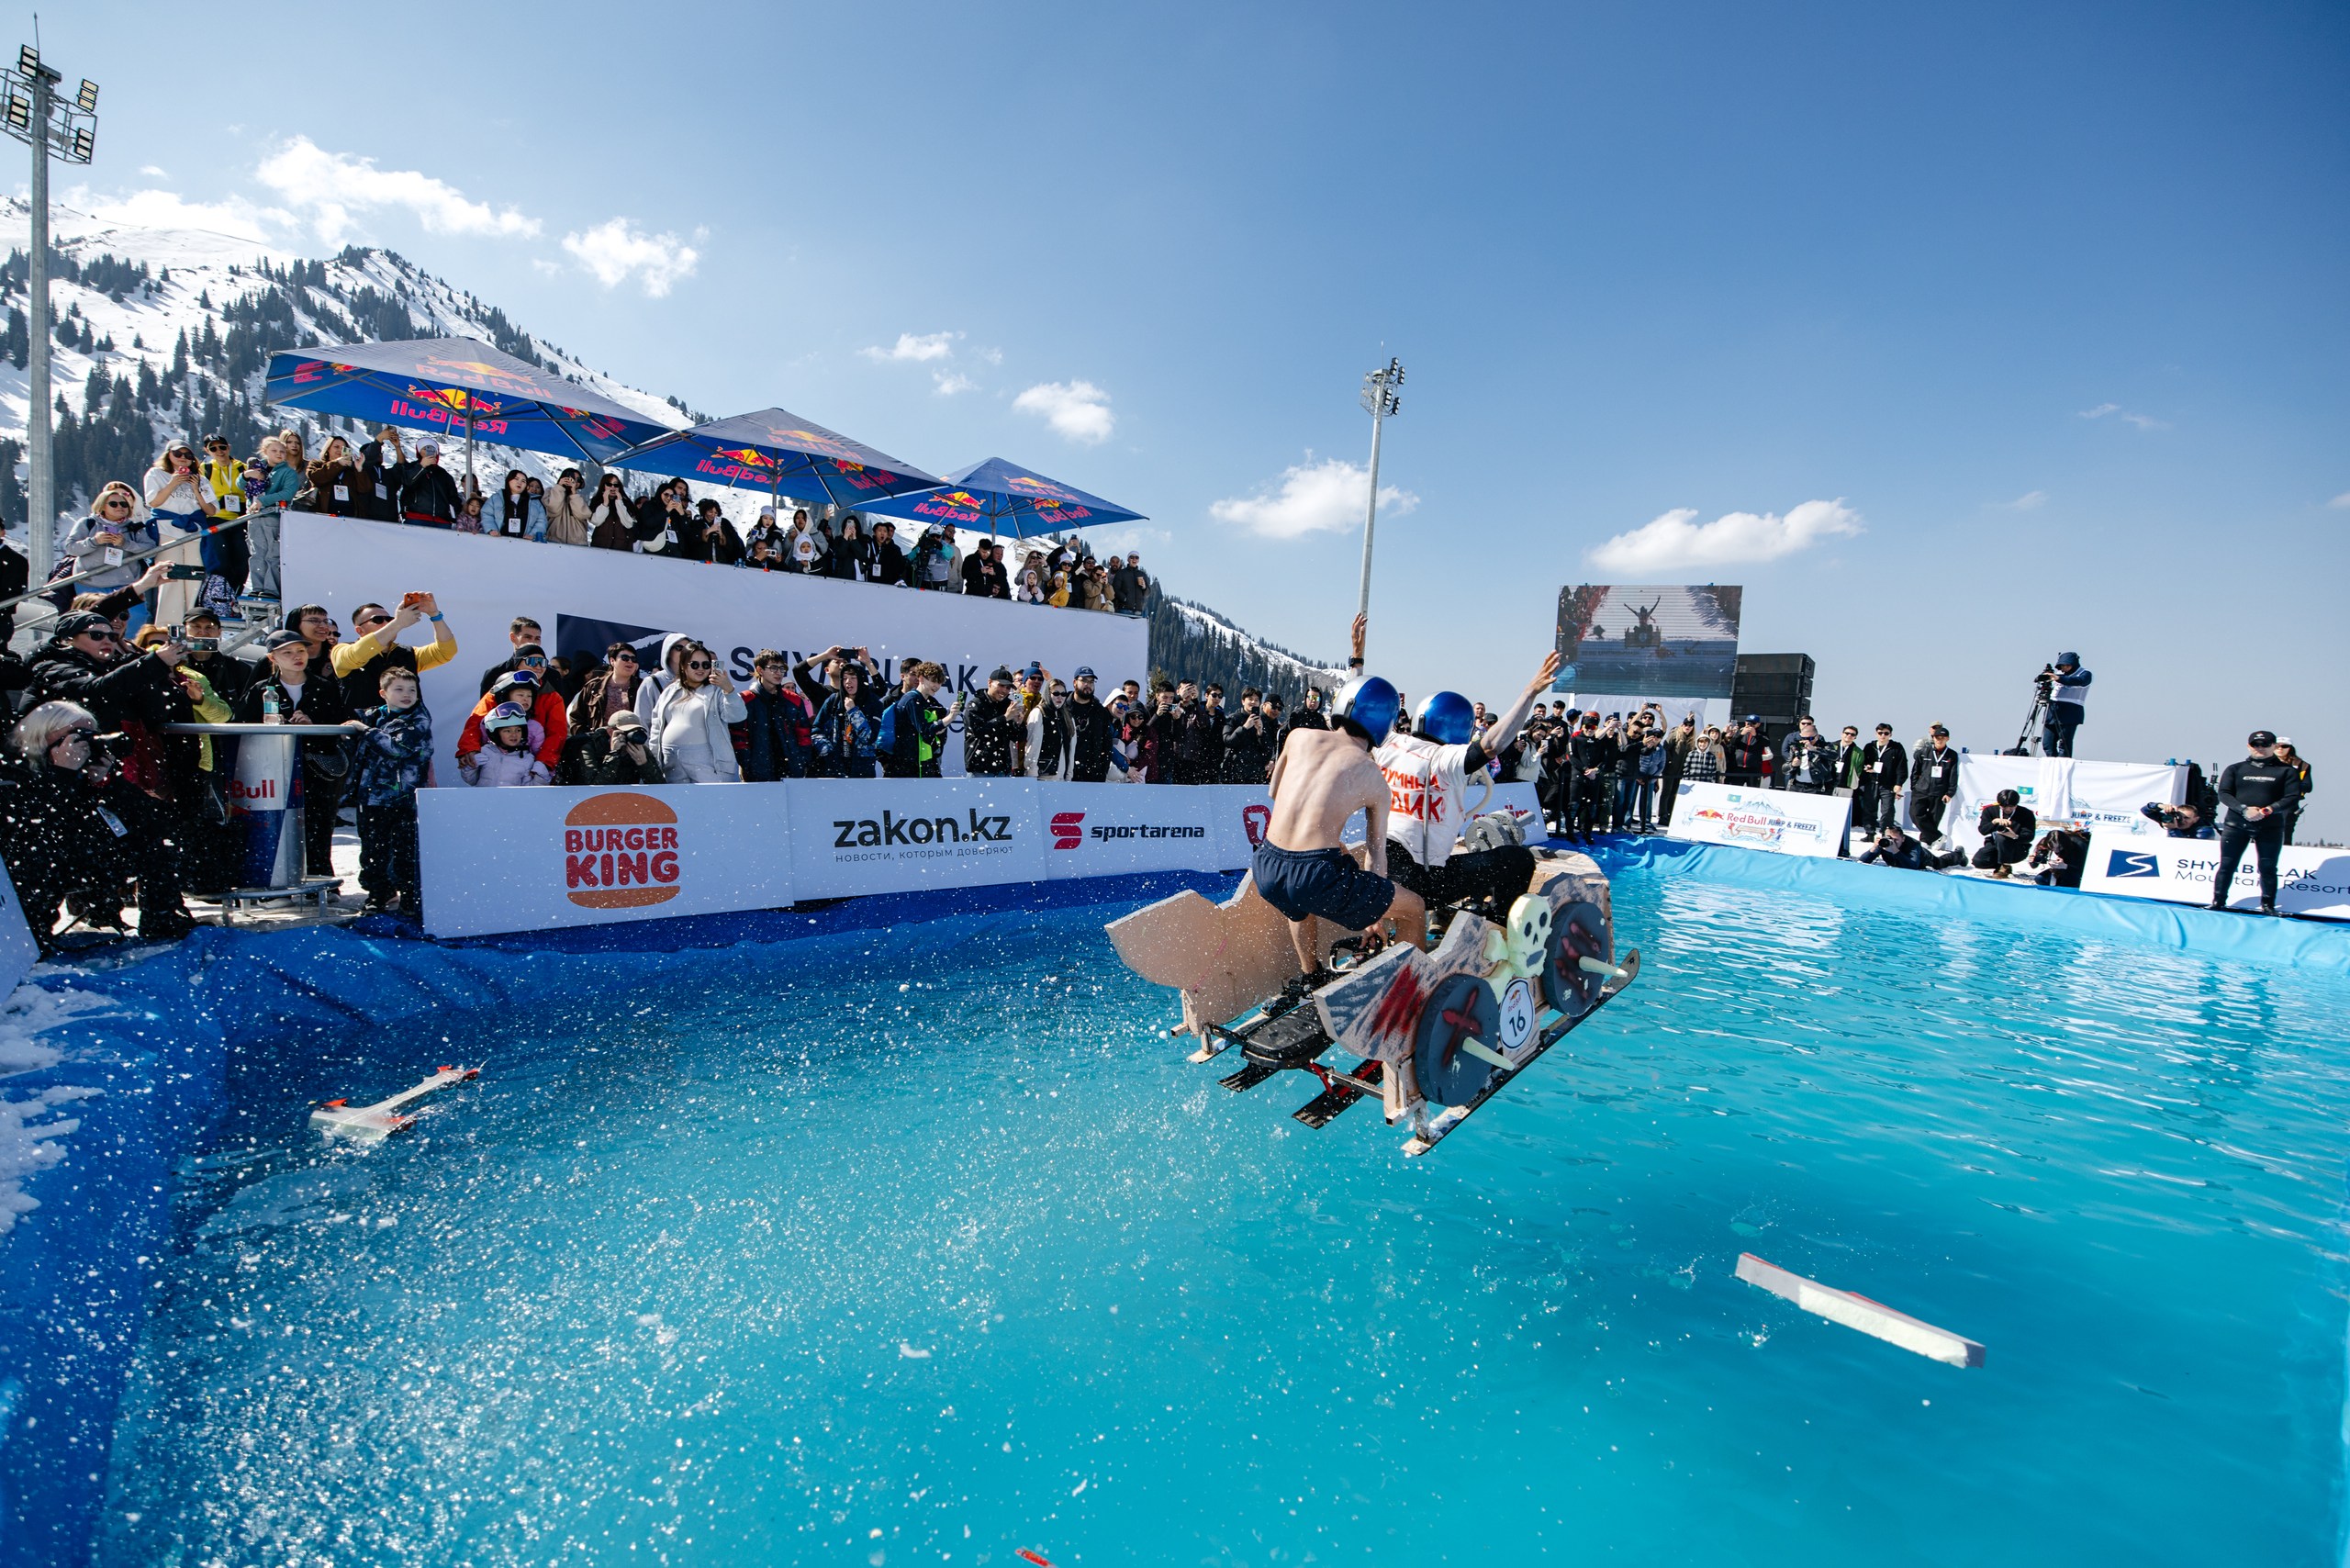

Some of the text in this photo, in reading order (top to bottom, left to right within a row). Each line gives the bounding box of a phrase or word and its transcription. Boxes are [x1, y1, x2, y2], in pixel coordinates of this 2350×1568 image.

[416, 364, 553, 399] Red Bull
[231, 779, 275, 799] Bull
[833, 808, 1013, 848] zakon.kz
[1091, 823, 1204, 842] sportarena
[1727, 813, 1746, 823] Red
[1747, 815, 1767, 825] Bull
[1794, 822, 1817, 832] FREEZE
[565, 827, 679, 853] BURGER
[835, 846, 1014, 863] новости, которым доверяют
[565, 851, 680, 889] KING
[2283, 879, 2350, 895] Resort
[1508, 1009, 1527, 1037] 16
